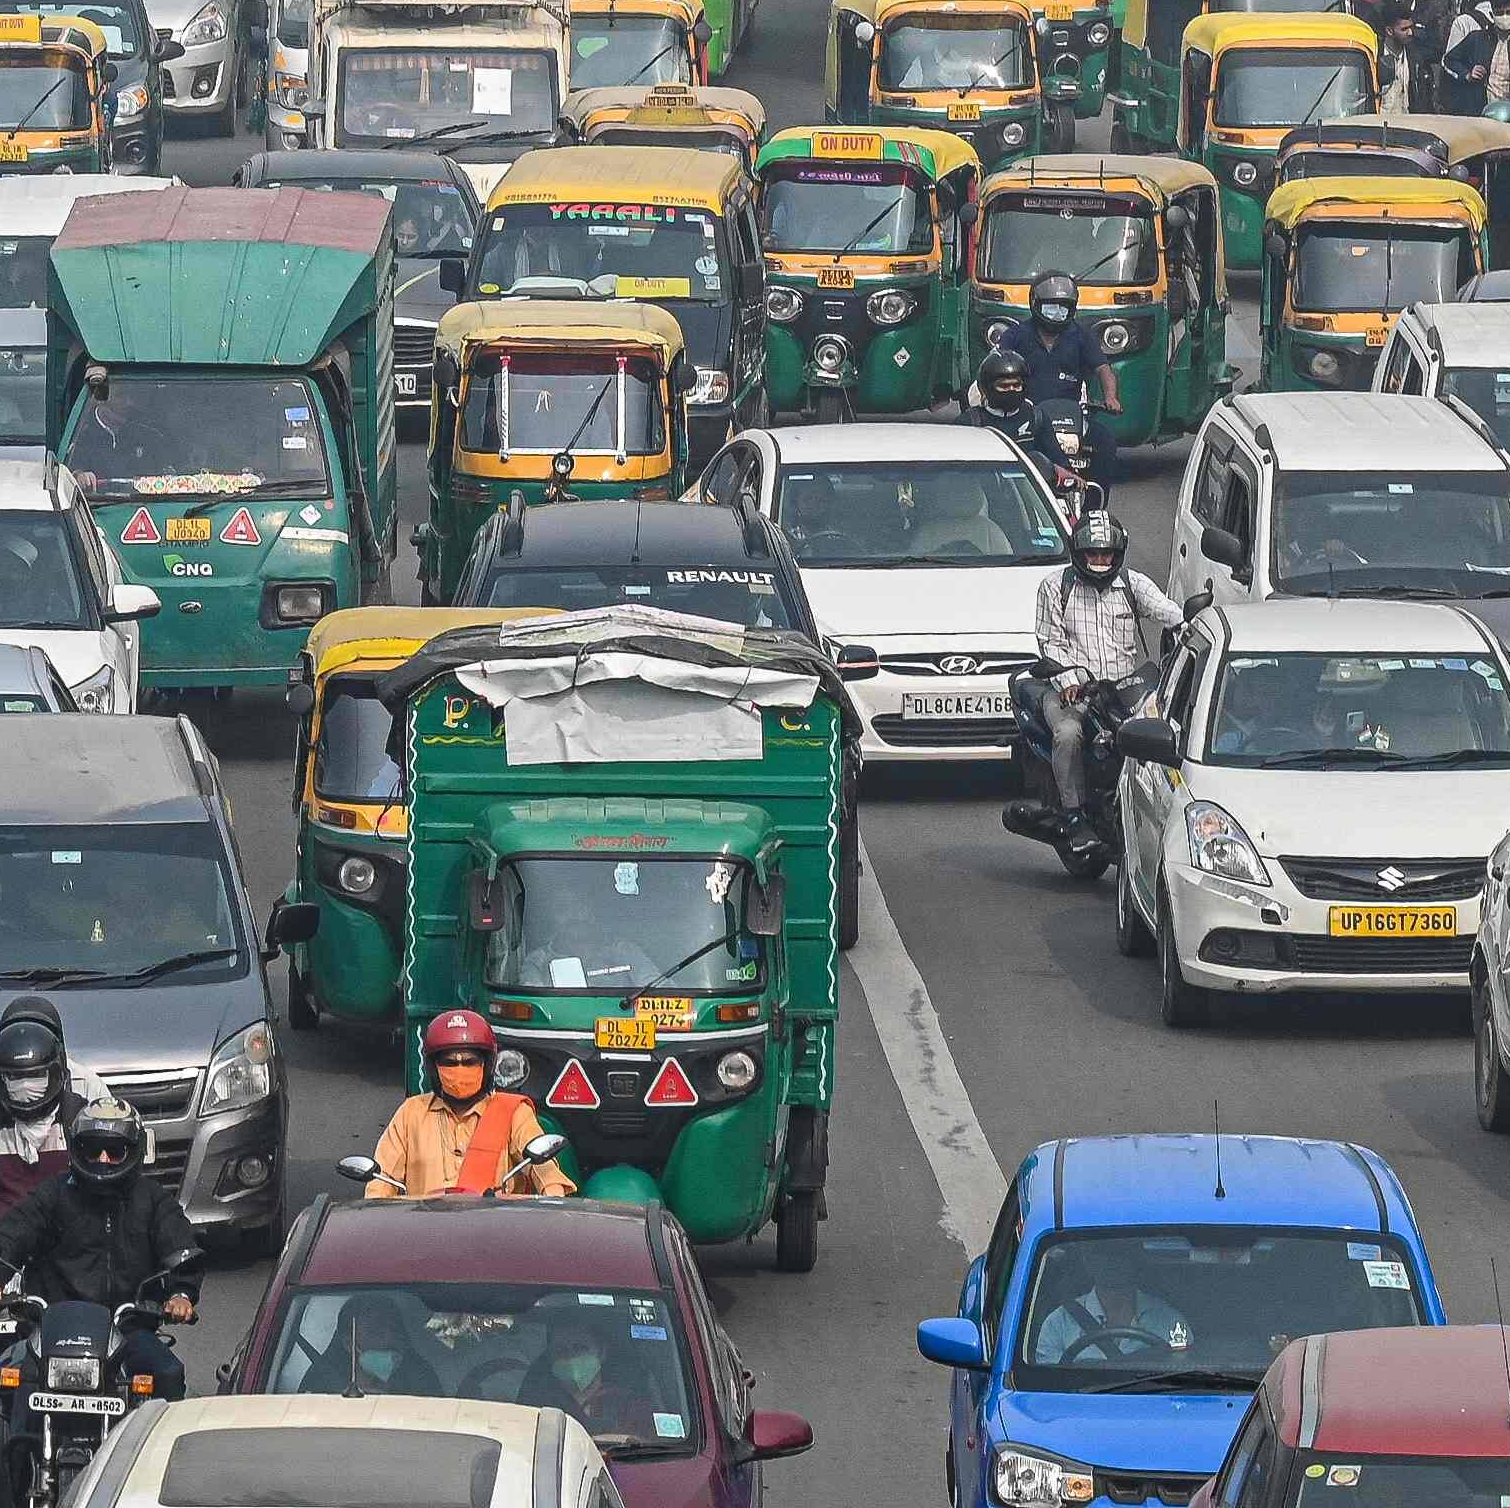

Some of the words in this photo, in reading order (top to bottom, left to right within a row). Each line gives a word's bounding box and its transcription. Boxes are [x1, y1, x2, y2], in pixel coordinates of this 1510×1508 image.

[820, 136, 838, 151] ON
[841, 136, 874, 151] DUTY
[549, 203, 676, 223] YAAALI
[172, 563, 213, 577] CNG
[667, 571, 775, 586] RENAULT
[914, 696, 1012, 714] DL8CAE4168
[1341, 911, 1453, 931] UP16GT7360
[607, 1021, 620, 1033] DL
[635, 1022, 646, 1033] 1L
[608, 1035, 647, 1047] Z0274
[71, 1398, 85, 1410] AR
